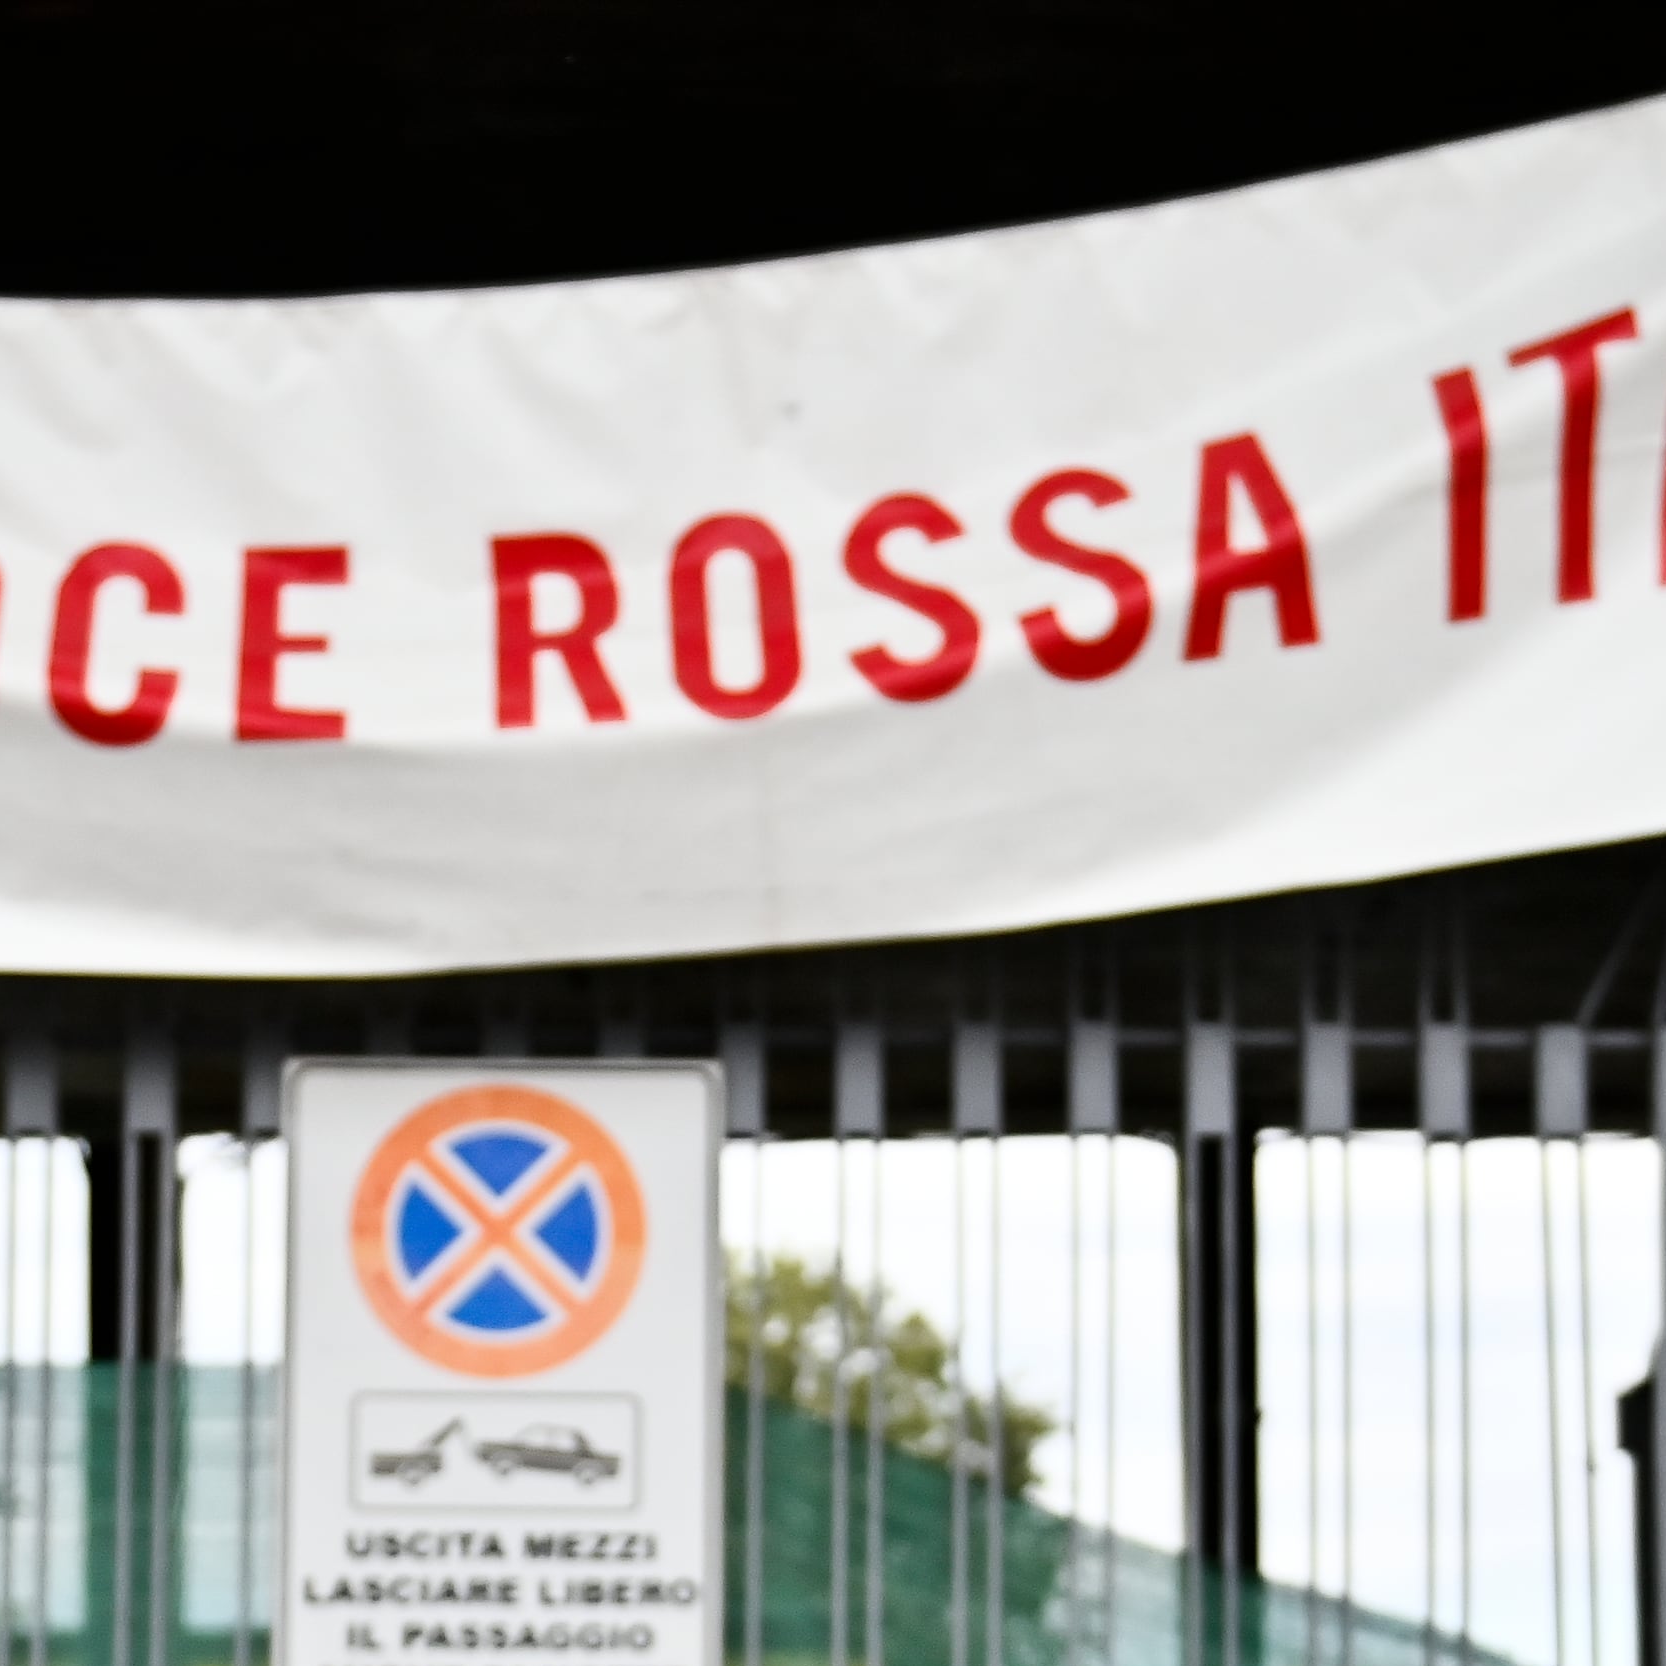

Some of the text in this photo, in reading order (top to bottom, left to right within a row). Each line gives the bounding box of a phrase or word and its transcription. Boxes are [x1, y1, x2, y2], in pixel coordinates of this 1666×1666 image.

[488, 430, 1322, 730] ROSSA
[345, 1532, 659, 1561] USCITA MEZZI
[302, 1577, 699, 1606] LASCIARE LIBERO
[345, 1623, 656, 1652] IL PASSAGGIO
